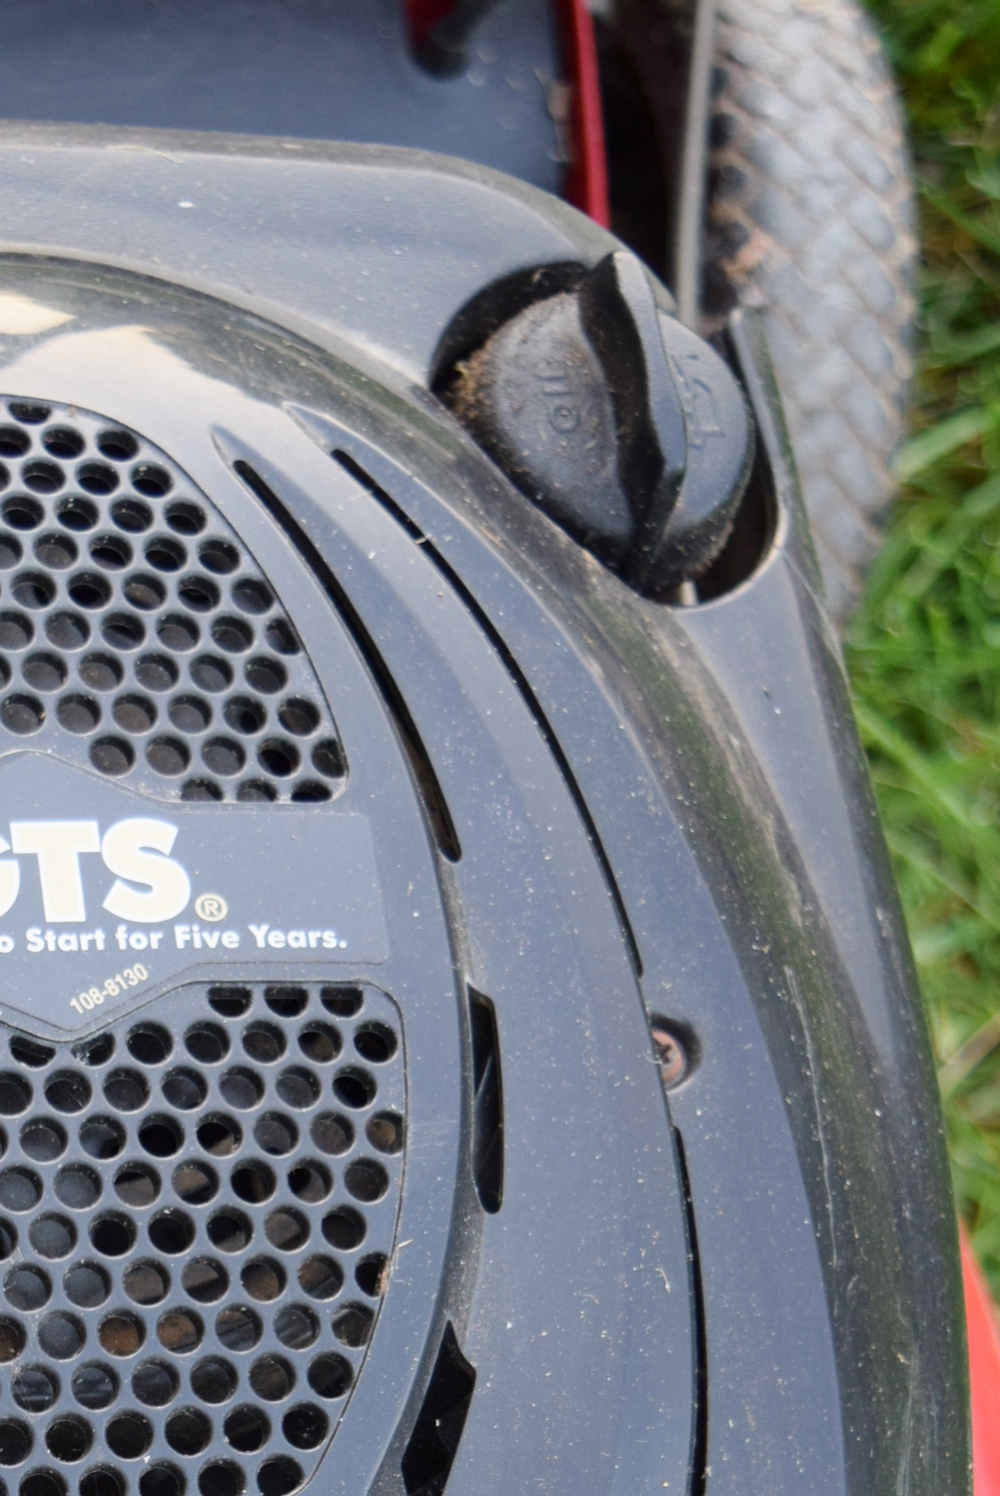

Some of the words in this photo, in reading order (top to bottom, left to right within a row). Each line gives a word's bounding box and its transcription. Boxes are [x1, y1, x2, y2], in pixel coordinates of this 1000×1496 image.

[25, 926, 105, 953] Start
[116, 924, 163, 950] for
[174, 924, 240, 949] Five
[248, 924, 347, 949] Years.
[69, 963, 149, 1015] 108-8130
